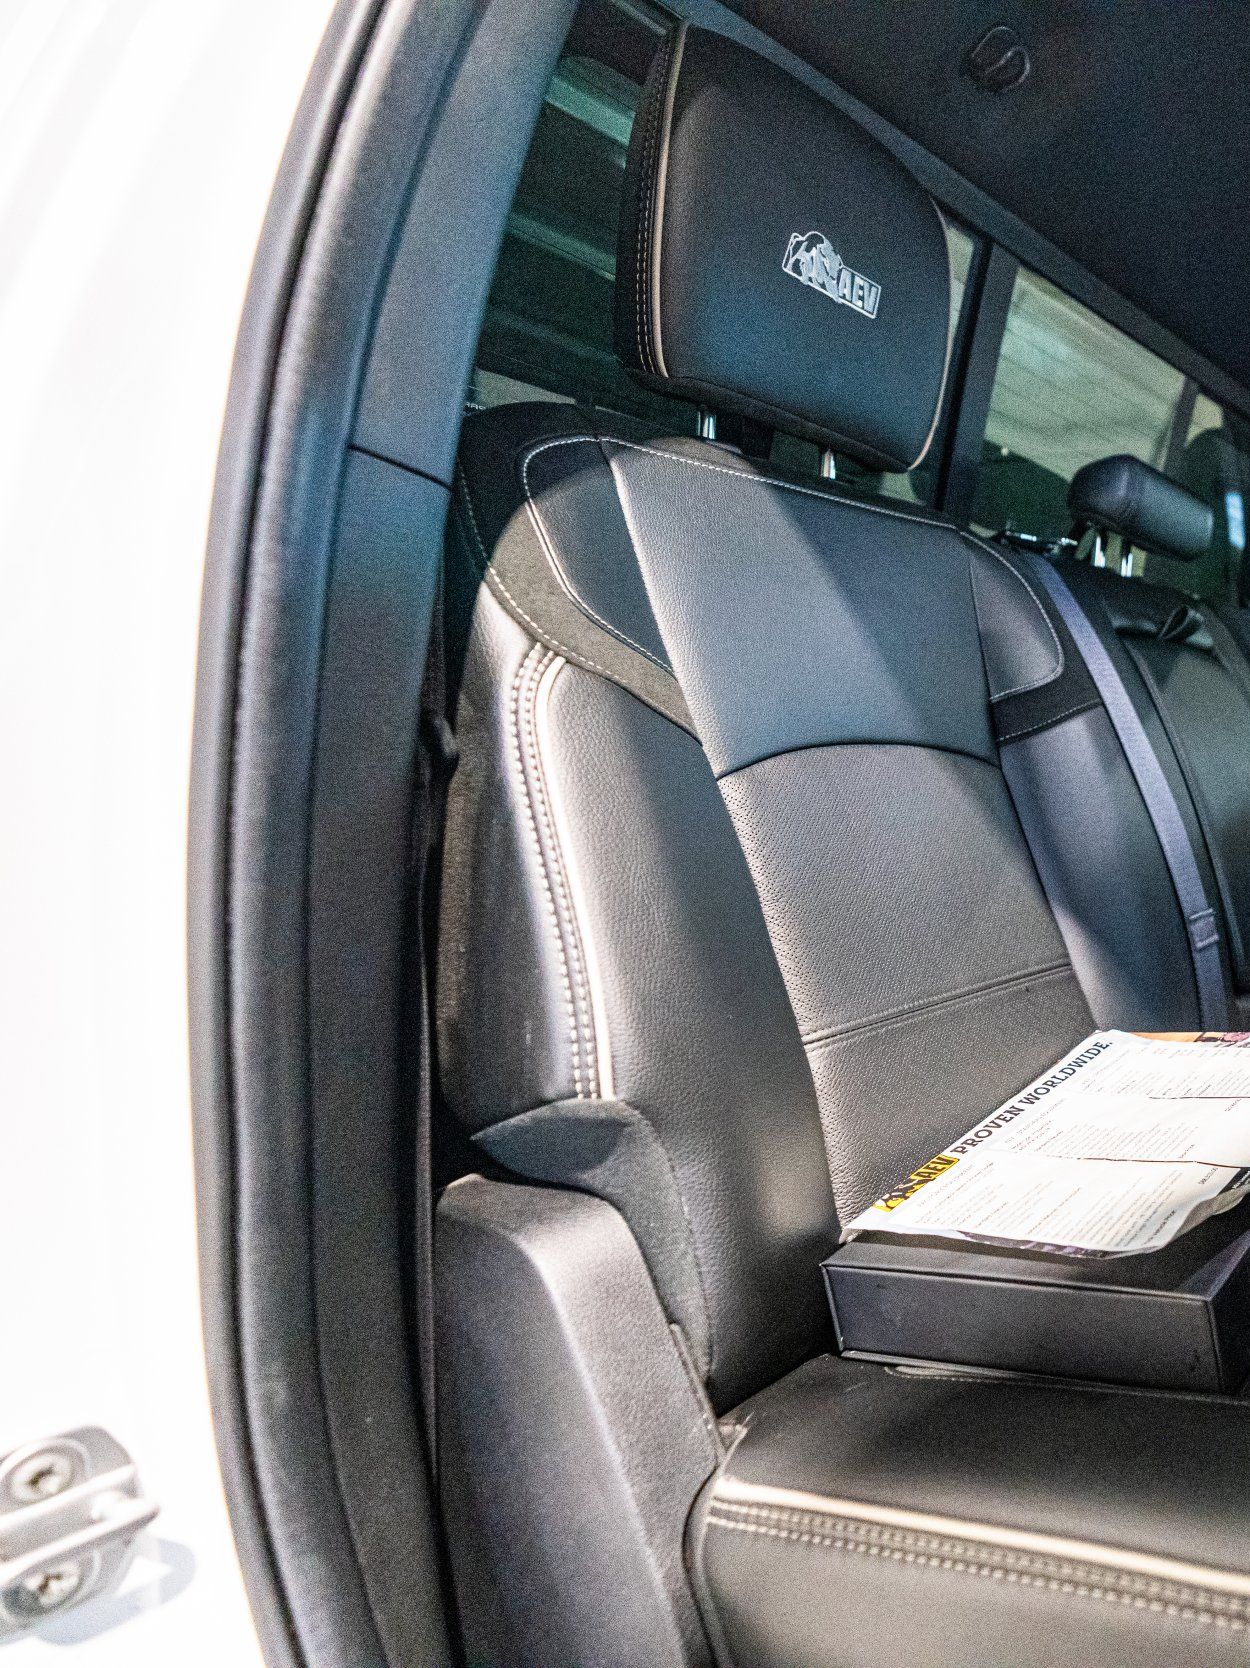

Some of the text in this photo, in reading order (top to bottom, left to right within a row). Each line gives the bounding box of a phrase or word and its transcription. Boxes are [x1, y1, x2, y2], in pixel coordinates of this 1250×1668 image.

[838, 268, 878, 312] AEV
[914, 1155, 956, 1180] AEV
[950, 1105, 1025, 1155] PROVEN
